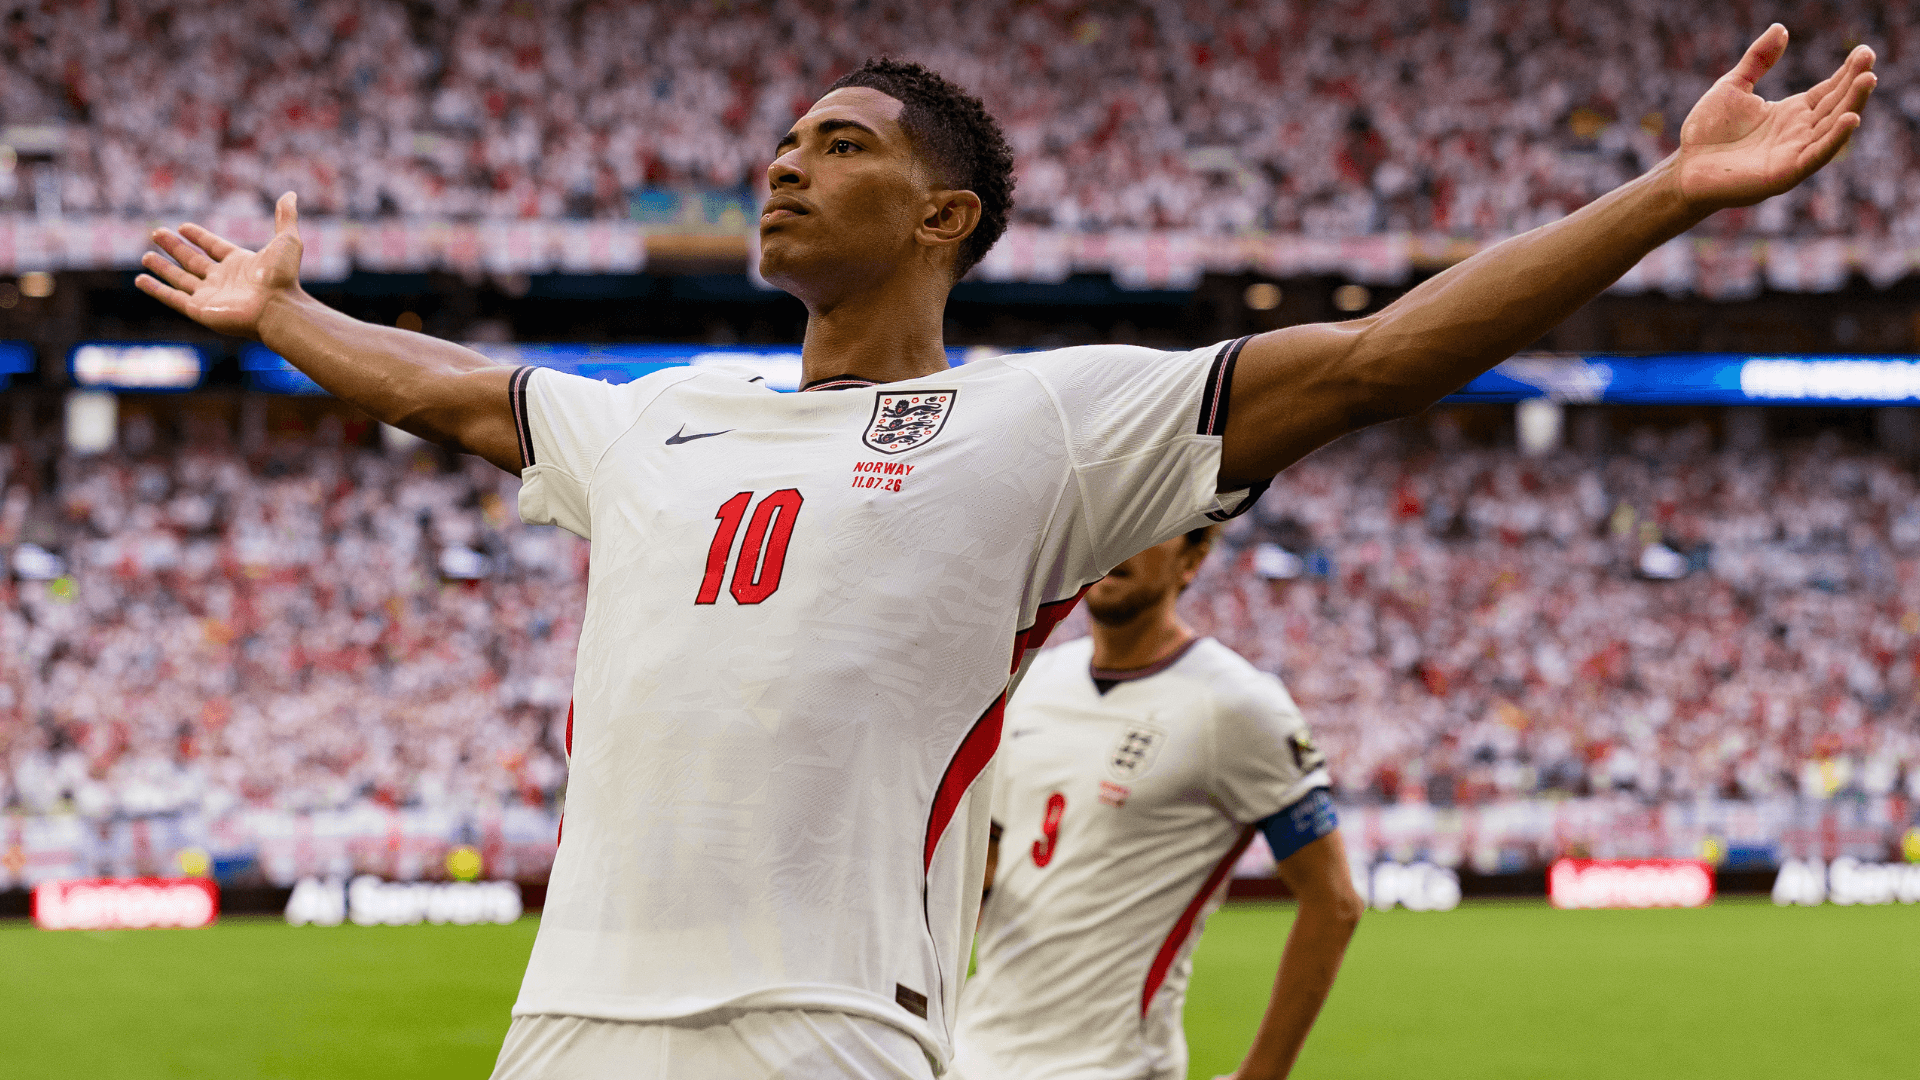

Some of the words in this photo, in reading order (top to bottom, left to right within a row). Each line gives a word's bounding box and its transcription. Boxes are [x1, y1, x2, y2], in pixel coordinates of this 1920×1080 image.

[851, 475, 903, 493] 11.07.26
[853, 461, 915, 480] NORWAY
[695, 488, 804, 605] 10
[1031, 791, 1066, 868] 9
